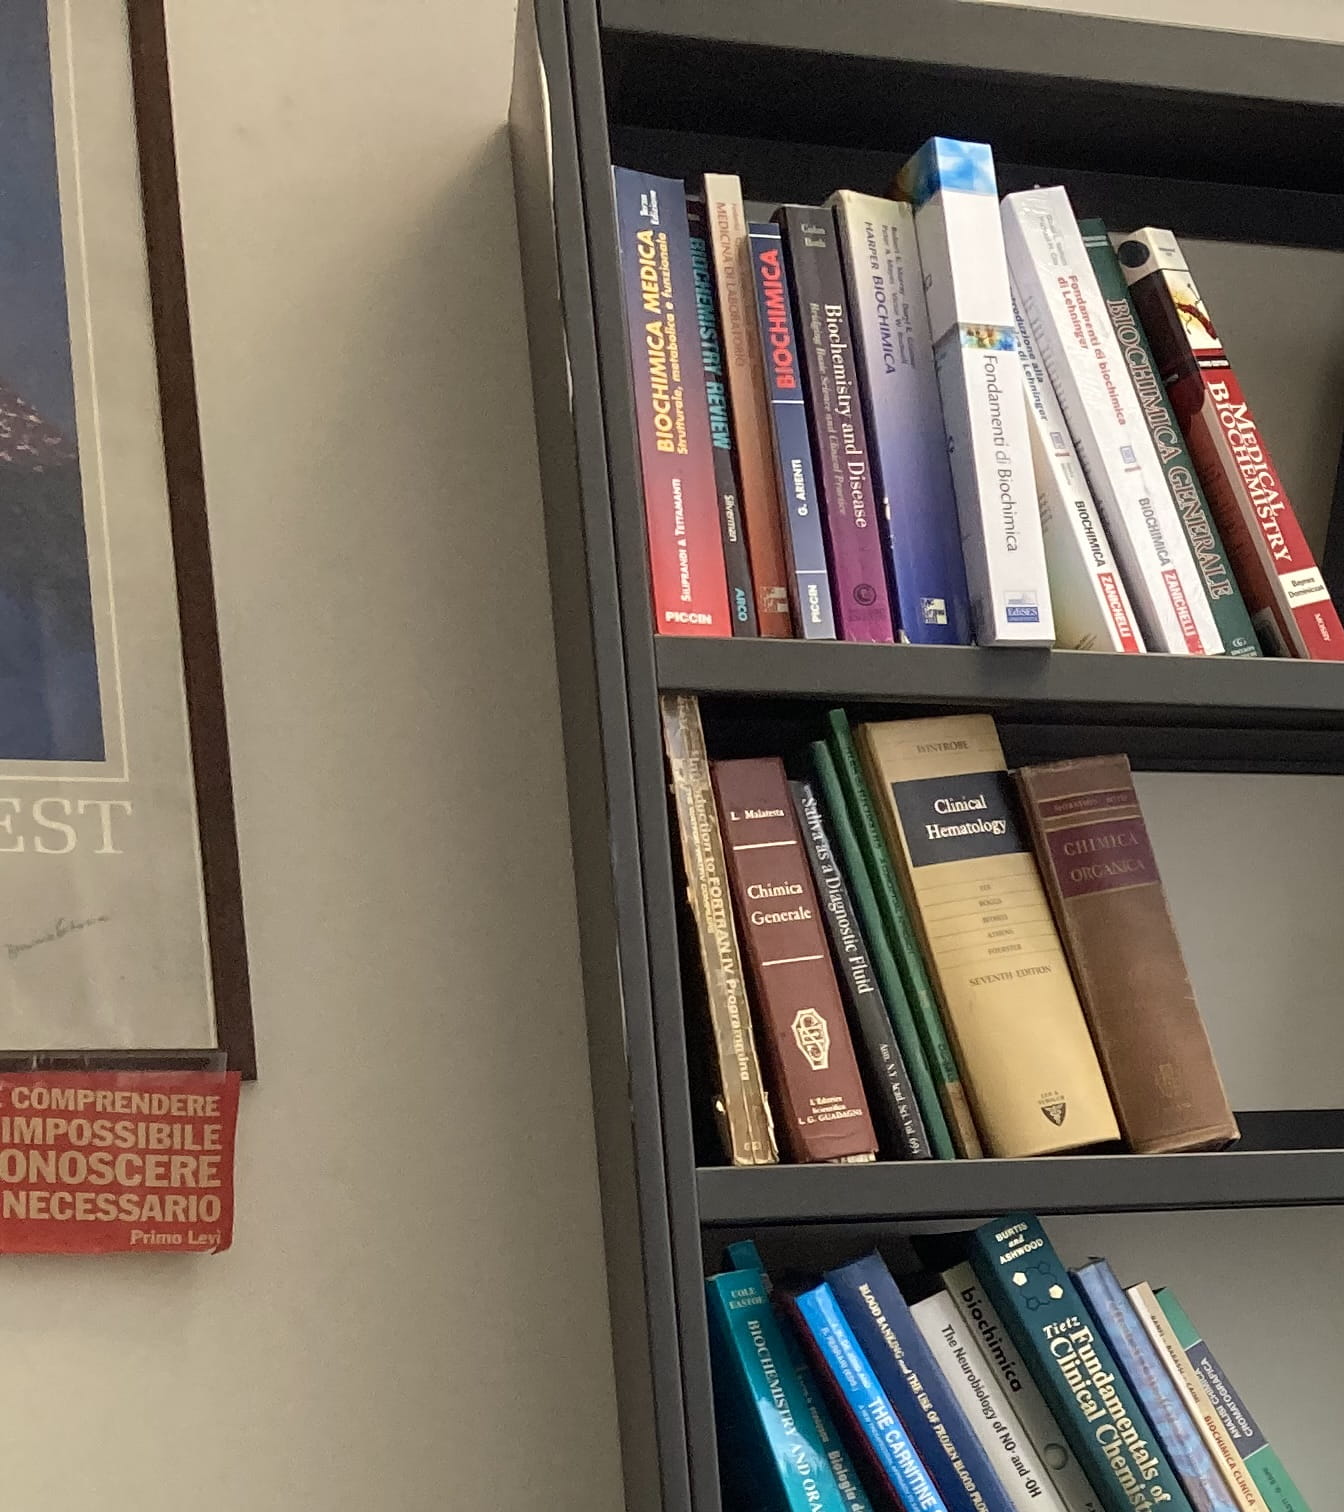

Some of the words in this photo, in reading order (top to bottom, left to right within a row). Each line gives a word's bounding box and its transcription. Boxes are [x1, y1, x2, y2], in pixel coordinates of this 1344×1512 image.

[638, 229, 660, 314] MEDICA
[864, 220, 878, 269] HARPER
[873, 274, 895, 373] BIOCHIMICA
[760, 249, 794, 390] BIOCHIMICA
[690, 236, 719, 375] BIOCHEMISTRY
[707, 379, 729, 450] REVIEW
[822, 302, 855, 417] Biochemistry
[647, 320, 673, 453] BIOCHIMICA
[984, 354, 1007, 446] Fondamenti
[842, 422, 861, 456] and
[995, 449, 1010, 466] di
[1108, 295, 1181, 461] BIOCHIMICA
[1168, 463, 1231, 599] GENERALE
[848, 460, 872, 528] Disease
[999, 467, 1019, 551] Biochimica
[724, 493, 737, 542] Silverman
[1075, 498, 1105, 567] BIOCHIMICA
[1139, 496, 1170, 566] BIOCHIMICA
[665, 611, 712, 625] PICCIN
[735, 587, 747, 621] ARCO
[808, 584, 821, 623] PICCIN
[1102, 574, 1130, 639] ZANICHELLI
[1165, 571, 1195, 637] ZANICHELLI
[744, 808, 784, 819] Malatesta
[801, 796, 826, 841] Saliva
[934, 794, 988, 814] Clinical
[925, 818, 1007, 840] Hematology
[1064, 831, 1139, 856] CHIMICA
[815, 843, 830, 861] as
[820, 863, 832, 874] a
[747, 881, 803, 899] Chimica
[751, 906, 812, 925] Generale
[822, 875, 858, 954] Diagnostic
[850, 954, 872, 993] Fluid
[969, 972, 1013, 986] SEVENTH
[1016, 965, 1052, 978] EDITION
[11, 1086, 221, 1117] COMPRENDERE
[2, 1117, 223, 1150] IMPOSSIBILE
[3, 1190, 222, 1223] NECESSARIO
[130, 1229, 182, 1245] Primo
[188, 1230, 222, 1248] Levi
[995, 1221, 1029, 1242] BURTIS
[999, 1238, 1044, 1265] ASHWOOD
[960, 1286, 1027, 1392] biochimica
[1042, 1315, 1079, 1338] Tietz
[747, 1318, 796, 1437] BIOCHEMISTRY
[790, 1442, 810, 1476] AND
[1050, 1334, 1107, 1422] Clinical
[1193, 1366, 1220, 1406] CHIMICA
[1199, 1355, 1253, 1439] CROMATOGRAFICA
[1068, 1325, 1163, 1480] Fundamentals
[1148, 1483, 1171, 1502] of
[1216, 1404, 1241, 1440] ANALISI
[867, 1395, 893, 1429] THE
[884, 1428, 936, 1509] CARNITINE
